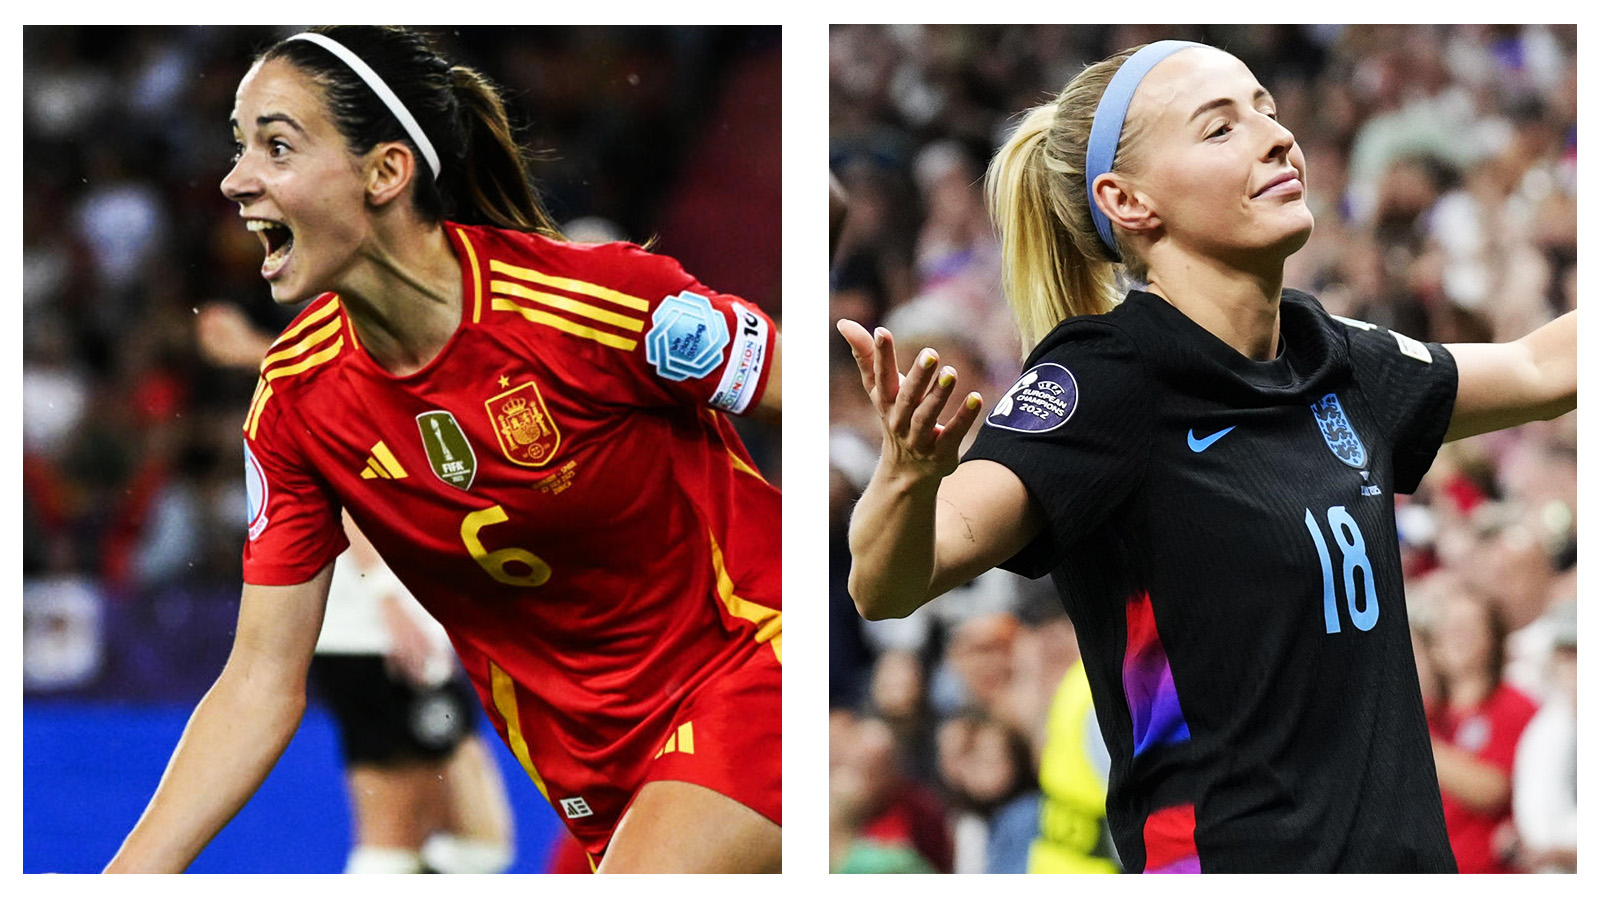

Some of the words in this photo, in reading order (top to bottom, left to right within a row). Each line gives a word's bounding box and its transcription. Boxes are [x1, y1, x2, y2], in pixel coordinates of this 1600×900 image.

[1022, 388, 1067, 409] EUROPEAN
[1038, 381, 1065, 396] UEFA
[1016, 394, 1065, 417] CHAMPIONS
[1019, 403, 1050, 420] 2022
[442, 460, 464, 474] FIFA
[460, 504, 552, 587] 6
[1304, 505, 1380, 634] 18
